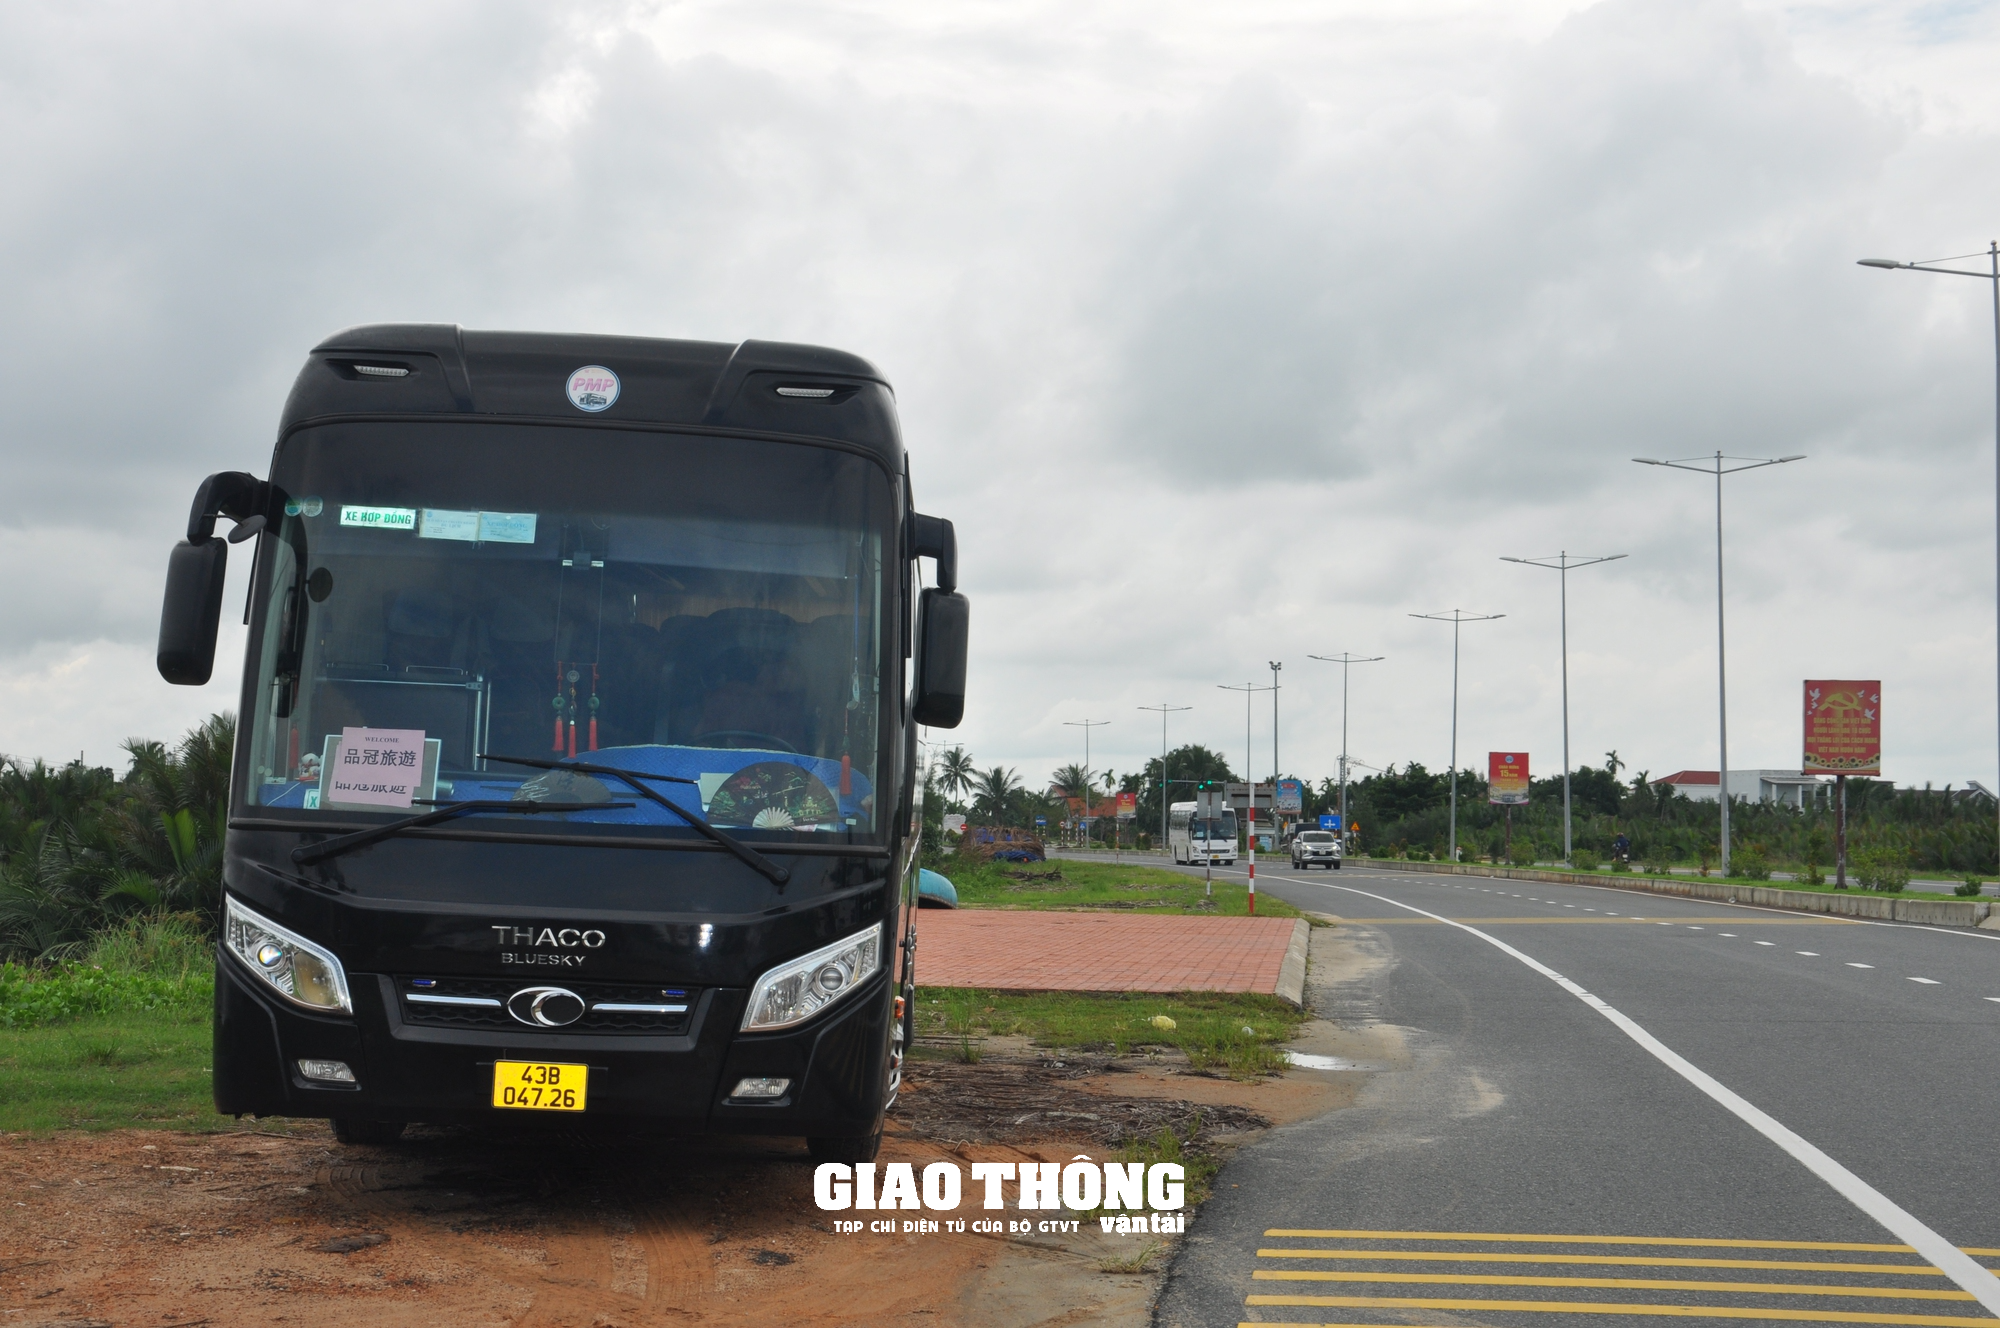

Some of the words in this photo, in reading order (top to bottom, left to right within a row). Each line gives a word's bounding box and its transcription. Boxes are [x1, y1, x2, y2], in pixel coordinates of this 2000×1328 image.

[572, 377, 615, 392] PMP
[345, 511, 358, 521] XE
[344, 748, 417, 767] 品冠旅遊
[491, 925, 606, 949] THACO
[501, 952, 586, 967] BLUESKY
[521, 1065, 561, 1086] 43B
[503, 1086, 576, 1108] 047.26
